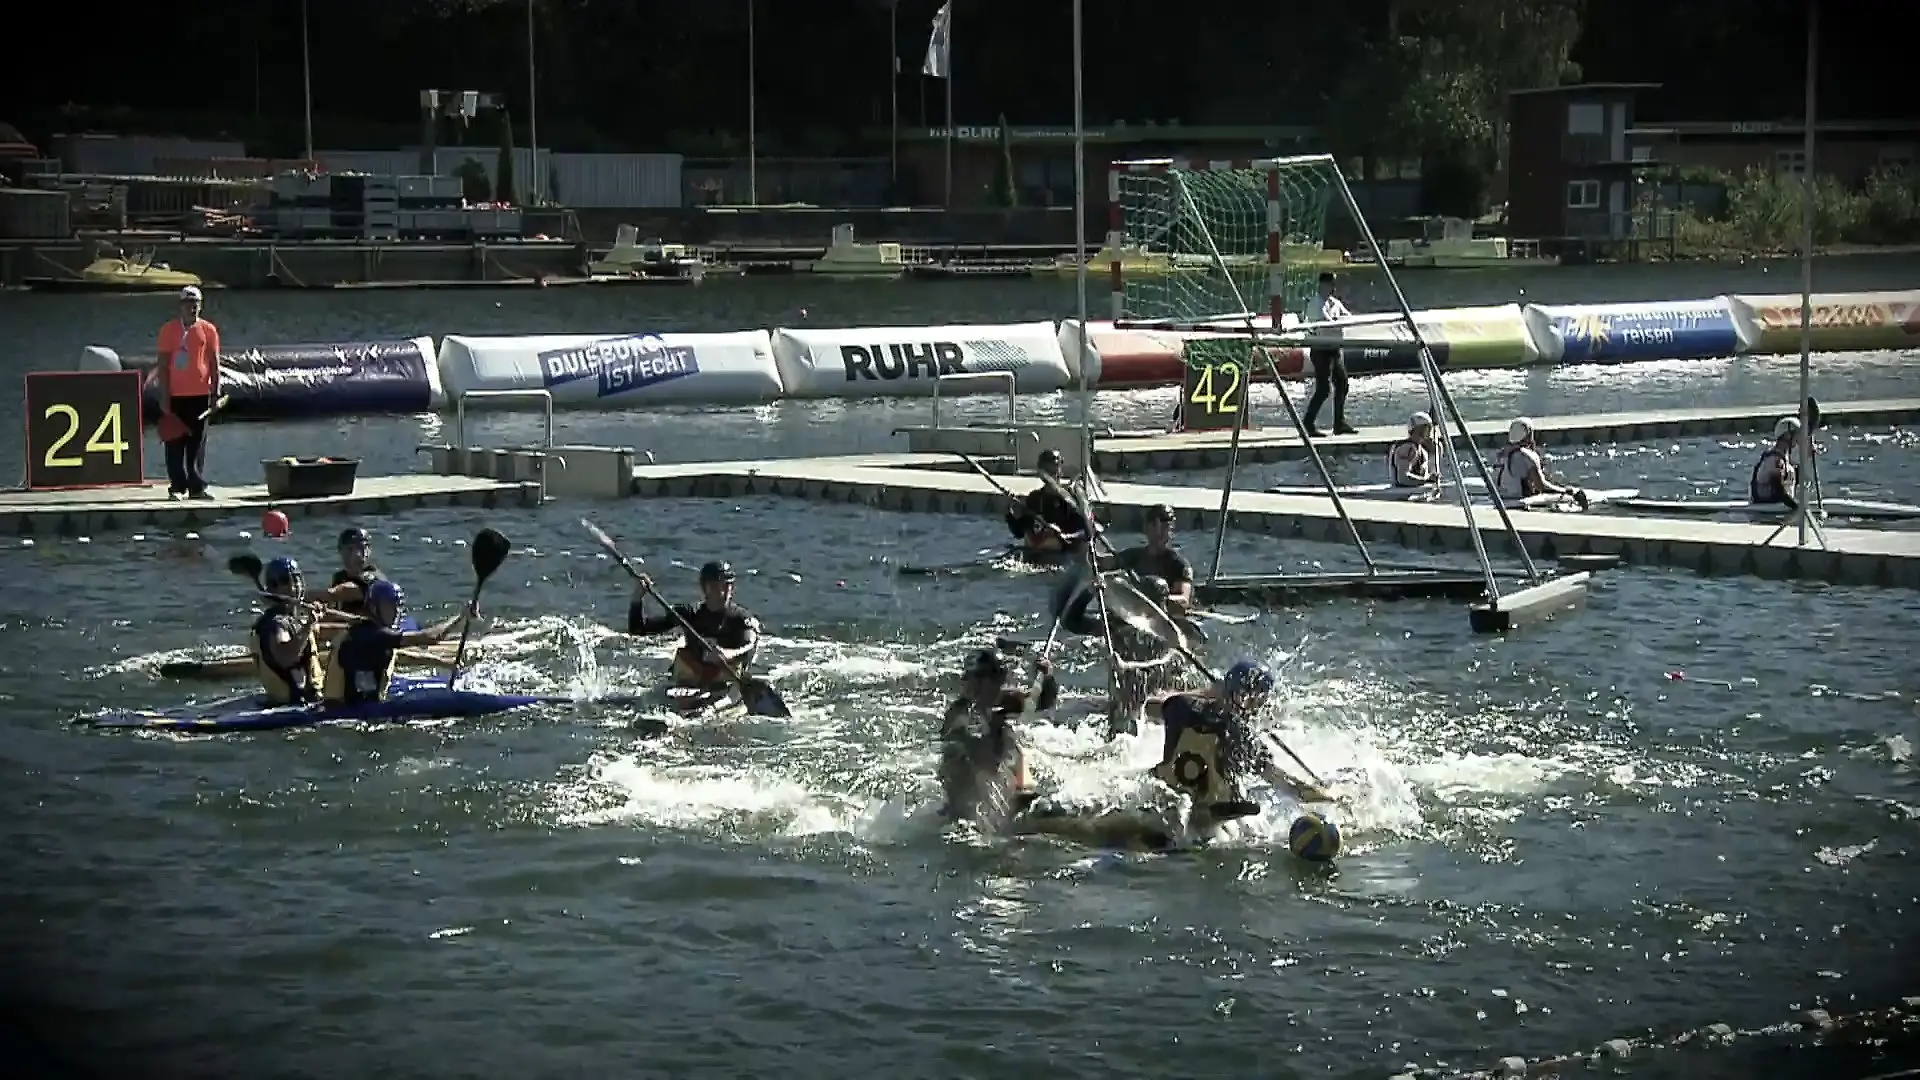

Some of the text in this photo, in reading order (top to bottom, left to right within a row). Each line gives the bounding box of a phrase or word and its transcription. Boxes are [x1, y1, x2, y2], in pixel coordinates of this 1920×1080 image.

[1621, 324, 1674, 345] reisen
[606, 351, 688, 389] IST ECHT
[839, 341, 968, 381] RUHR
[1191, 362, 1240, 415] 42
[43, 402, 129, 468] 24
